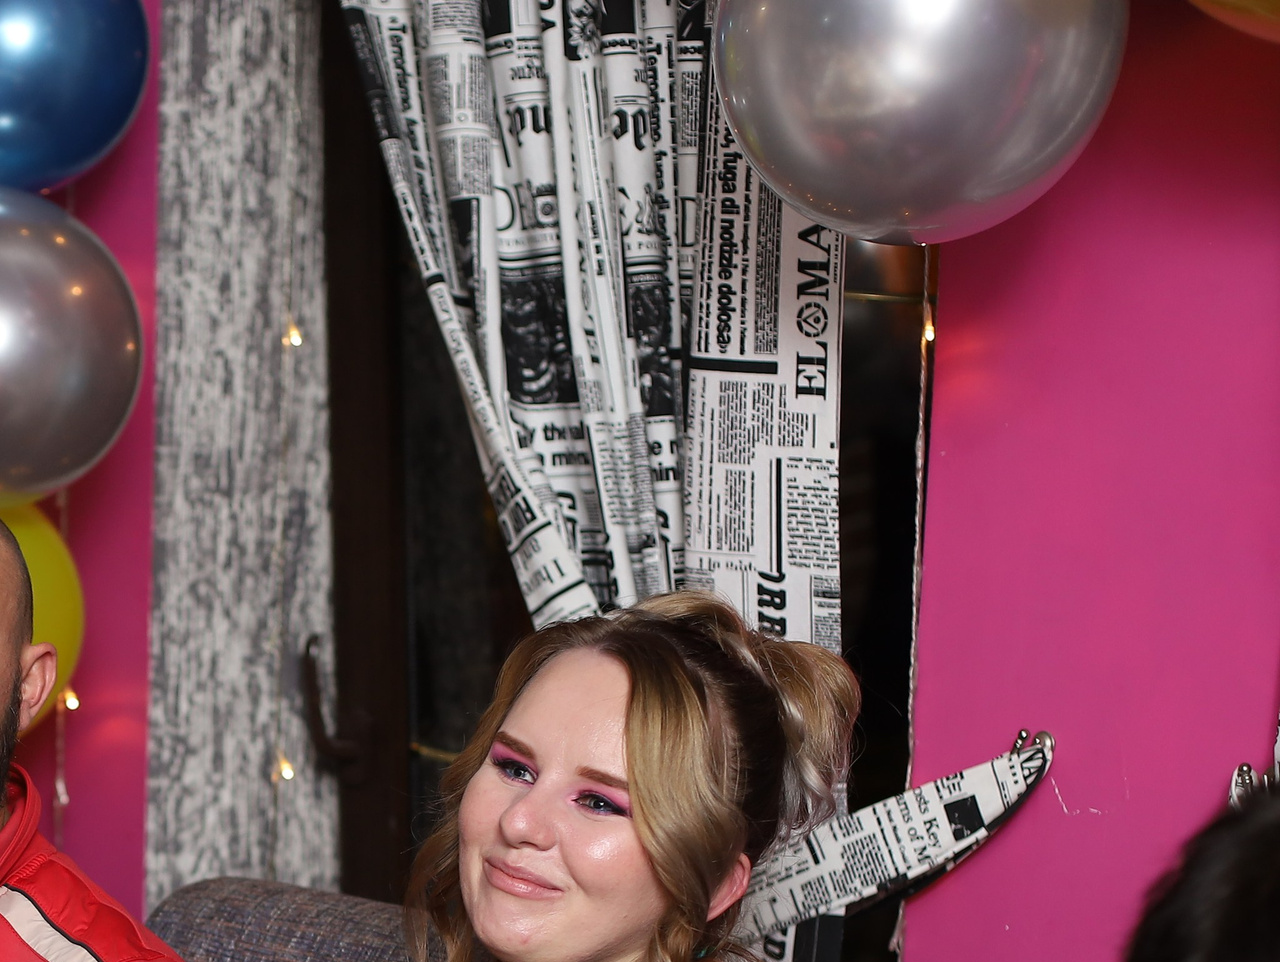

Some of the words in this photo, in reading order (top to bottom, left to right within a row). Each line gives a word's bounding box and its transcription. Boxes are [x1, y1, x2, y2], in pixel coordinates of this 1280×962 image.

[718, 151, 742, 194] fuga
[720, 196, 740, 215] di
[718, 218, 739, 280] notizie
[795, 340, 828, 400] EL
[907, 826, 924, 842] of
[923, 817, 942, 848] Key
